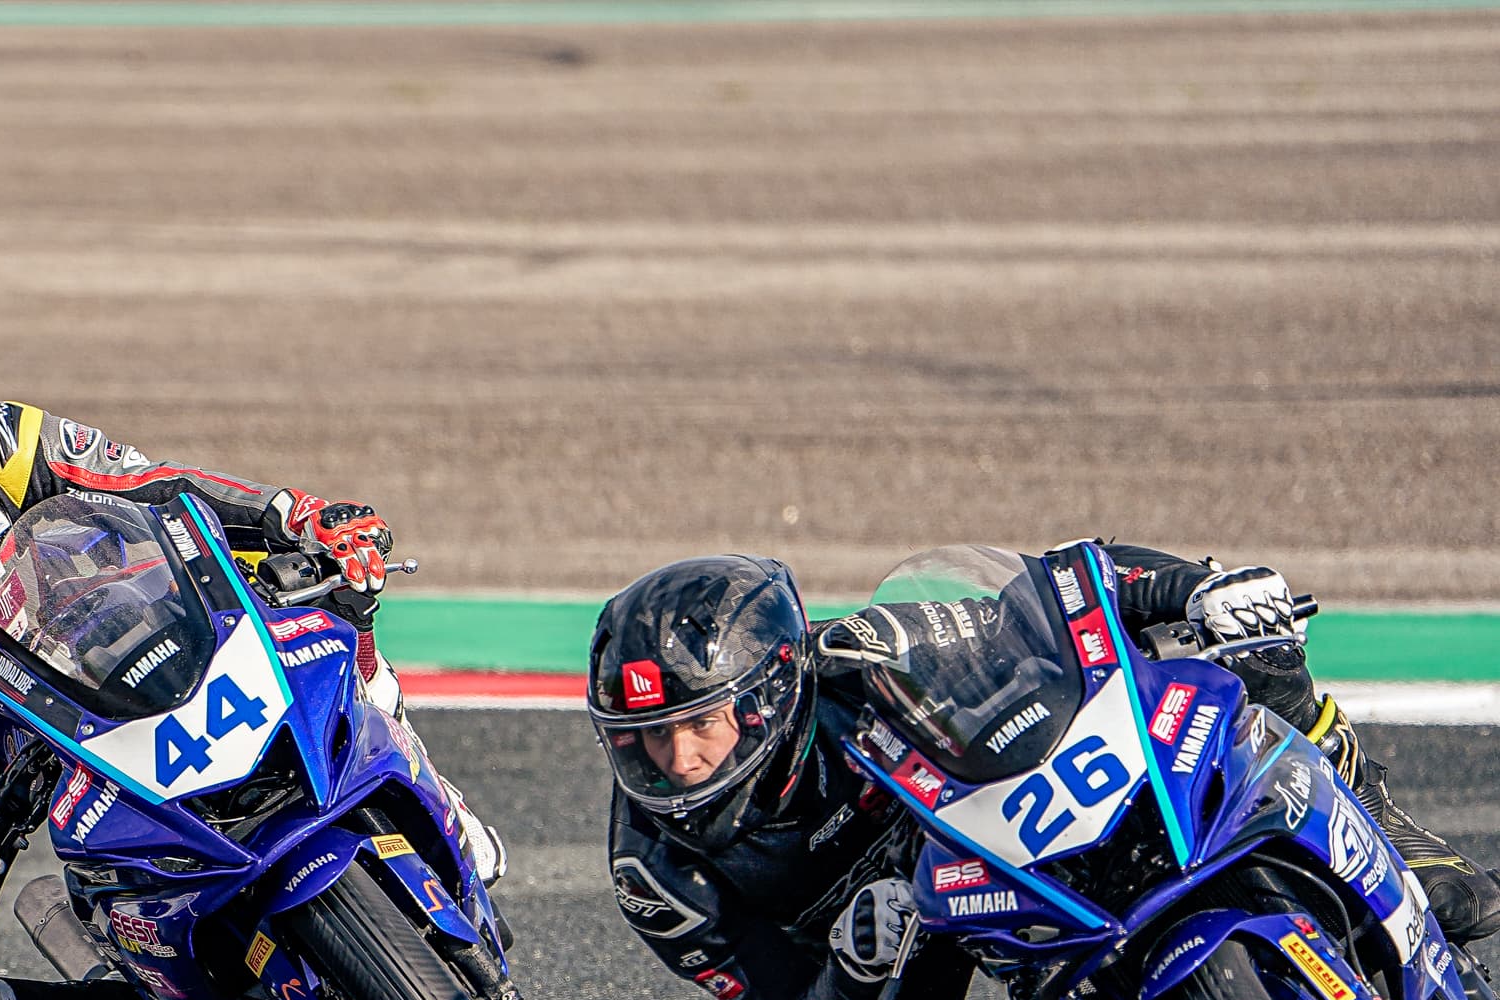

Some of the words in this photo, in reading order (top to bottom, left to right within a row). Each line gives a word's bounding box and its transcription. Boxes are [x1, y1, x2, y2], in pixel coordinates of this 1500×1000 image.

[121, 639, 181, 689] YAMAHA
[155, 673, 268, 788] 44
[986, 701, 1051, 755] YAMAHA
[1152, 687, 1186, 739] BS
[1172, 704, 1221, 774] YAMAHA
[71, 780, 121, 844] YAMAHA
[1002, 735, 1131, 859] 26
[284, 852, 338, 893] YAMAHA
[936, 862, 986, 886] BS
[949, 890, 1019, 917] YAMAHA
[248, 932, 275, 975] PIRELLI
[1151, 936, 1206, 981] YAMAHA
[1288, 940, 1348, 1000] PIRELLI
